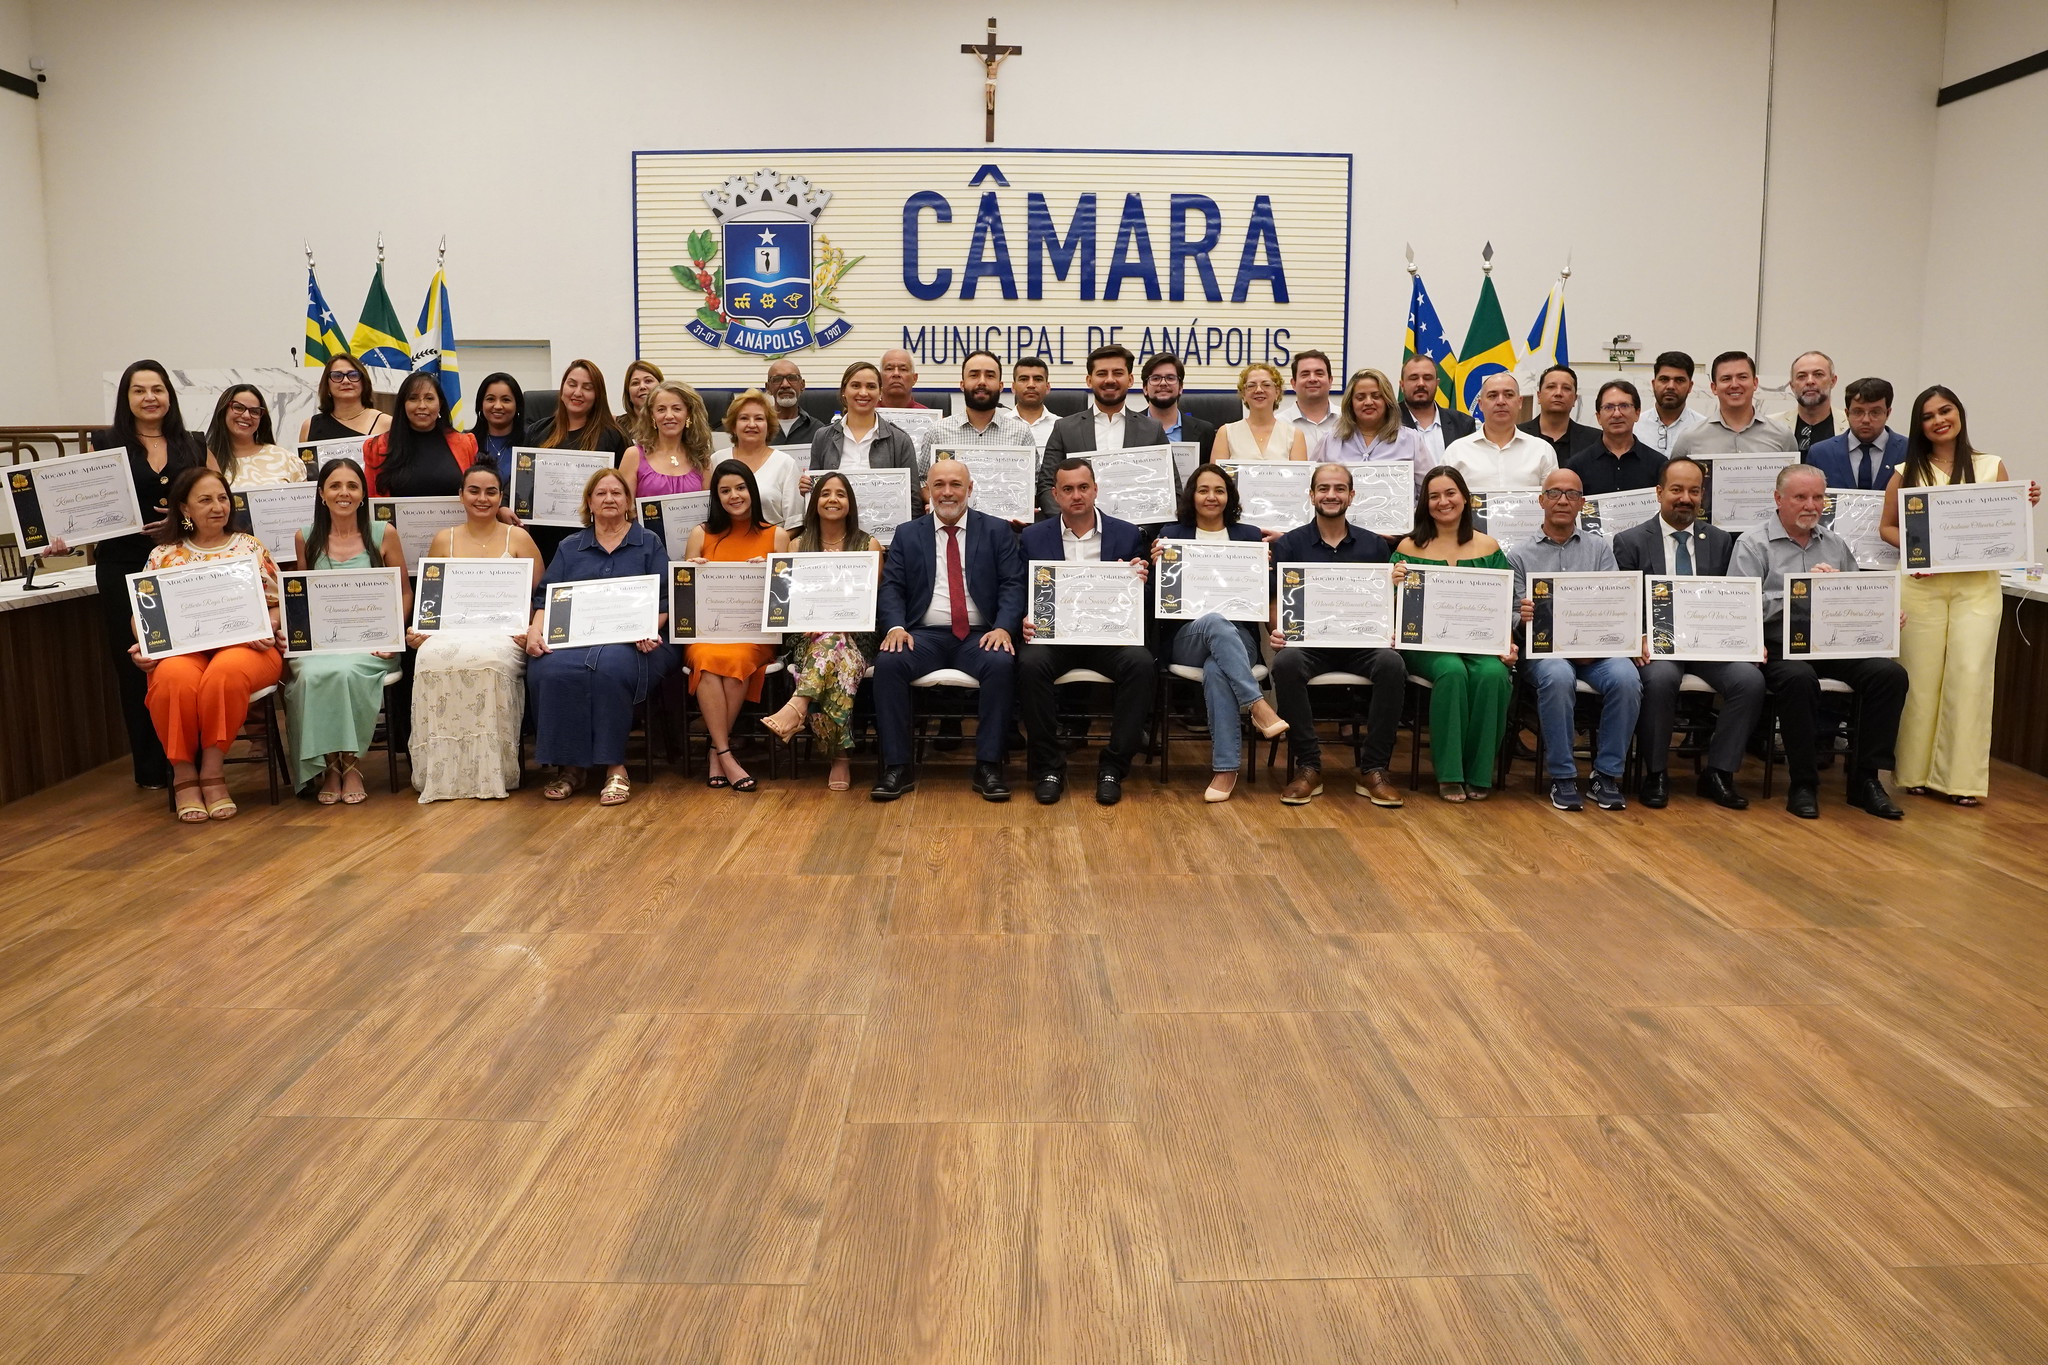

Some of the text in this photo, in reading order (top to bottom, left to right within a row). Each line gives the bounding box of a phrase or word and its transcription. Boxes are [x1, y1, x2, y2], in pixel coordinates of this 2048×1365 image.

[902, 164, 1290, 303] CÂMARA
[693, 324, 716, 343] 31-07
[734, 329, 804, 350] ANÁPOLIS
[824, 324, 842, 341] 1907
[903, 325, 1074, 365] MUNICIPAL
[1138, 318, 1291, 366] ANÁPOLIS
